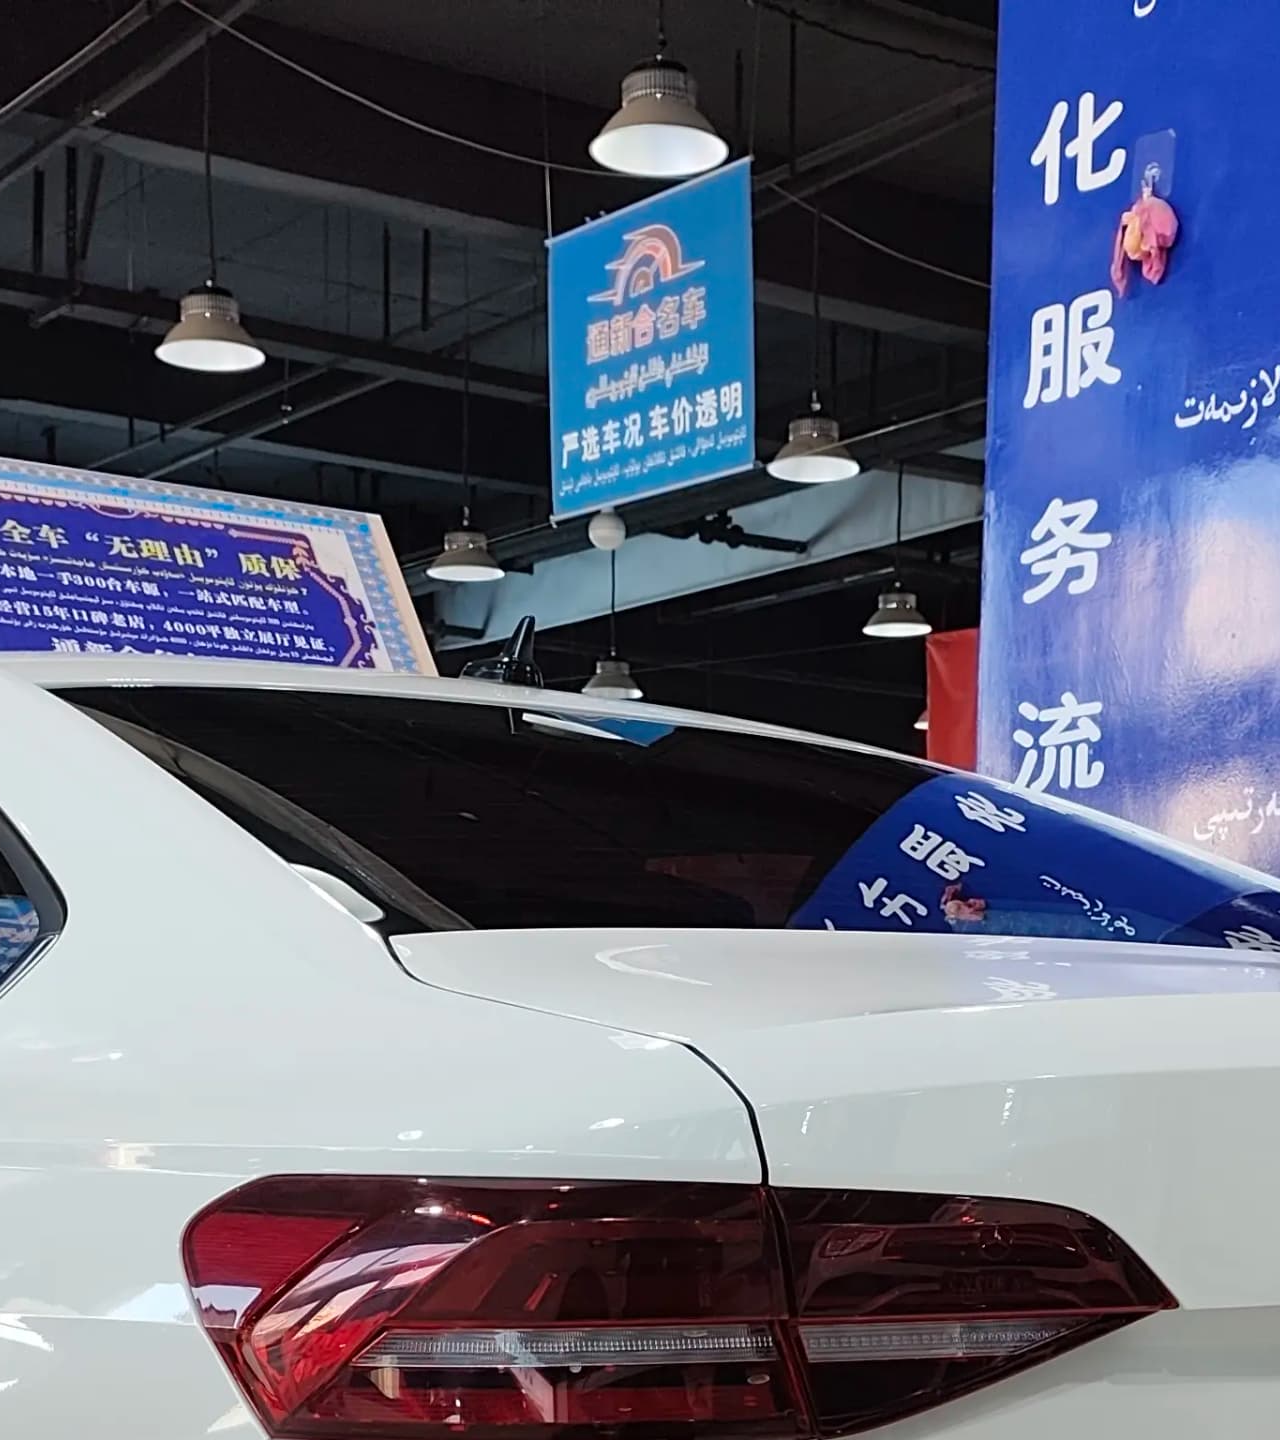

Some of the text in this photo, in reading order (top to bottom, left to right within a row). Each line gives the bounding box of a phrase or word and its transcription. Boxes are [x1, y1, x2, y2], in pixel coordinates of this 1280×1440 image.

[561, 411, 644, 469] 严选车况
[648, 381, 743, 441] 车价透明
[239, 552, 302, 581] 质保
